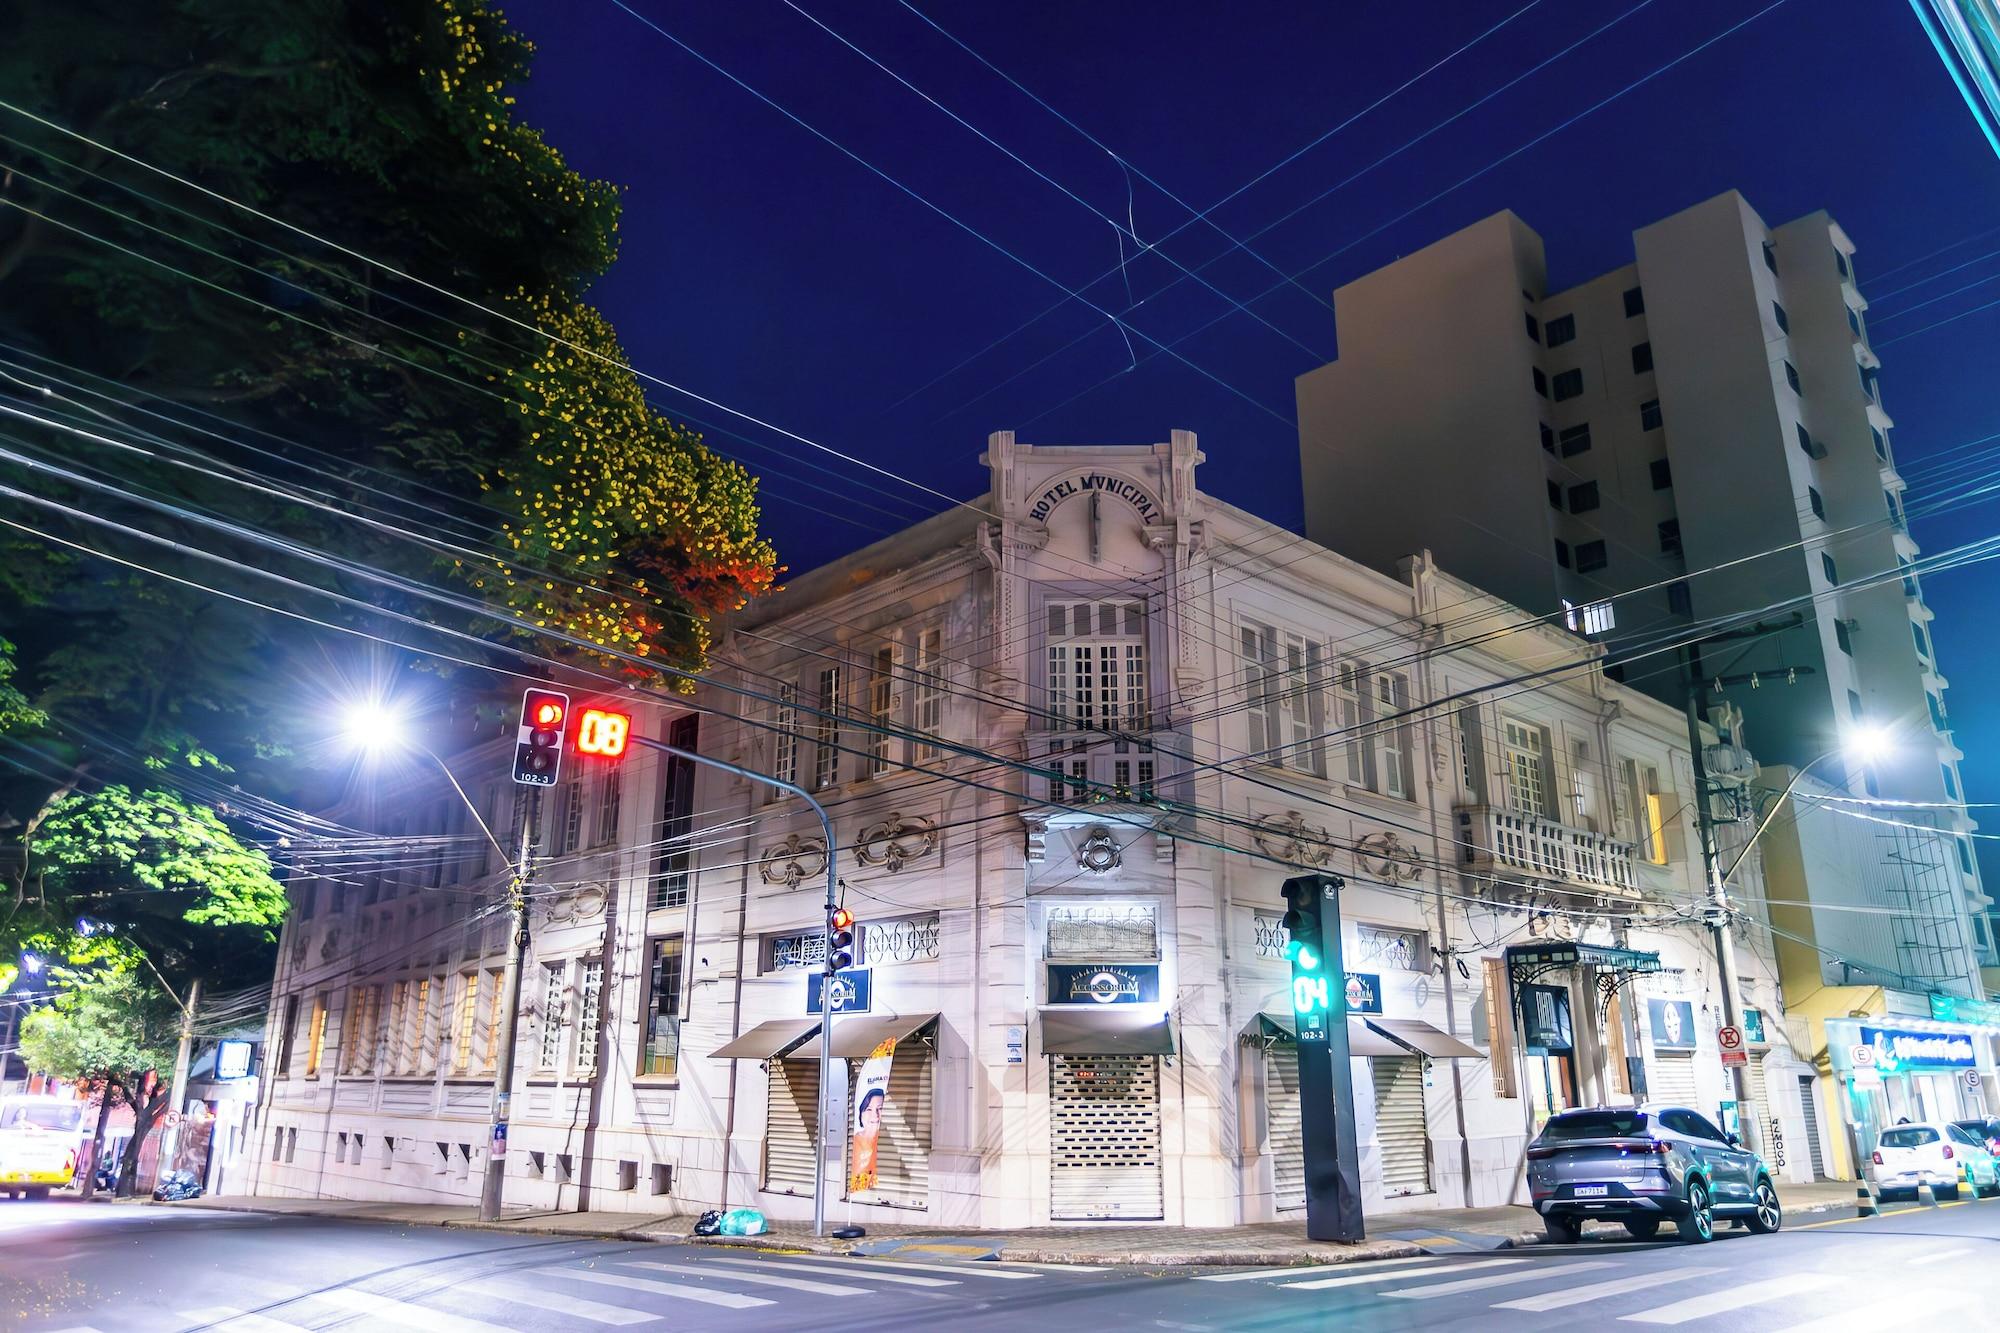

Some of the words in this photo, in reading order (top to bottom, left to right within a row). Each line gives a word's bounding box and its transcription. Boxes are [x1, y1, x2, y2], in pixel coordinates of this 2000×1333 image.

[1029, 480, 1078, 522] HOTEL
[578, 709, 629, 756] 08
[1069, 981, 1140, 997] ACCESSORIUM
[1293, 976, 1329, 1013] 04
[1301, 1031, 1324, 1040] 102-3
